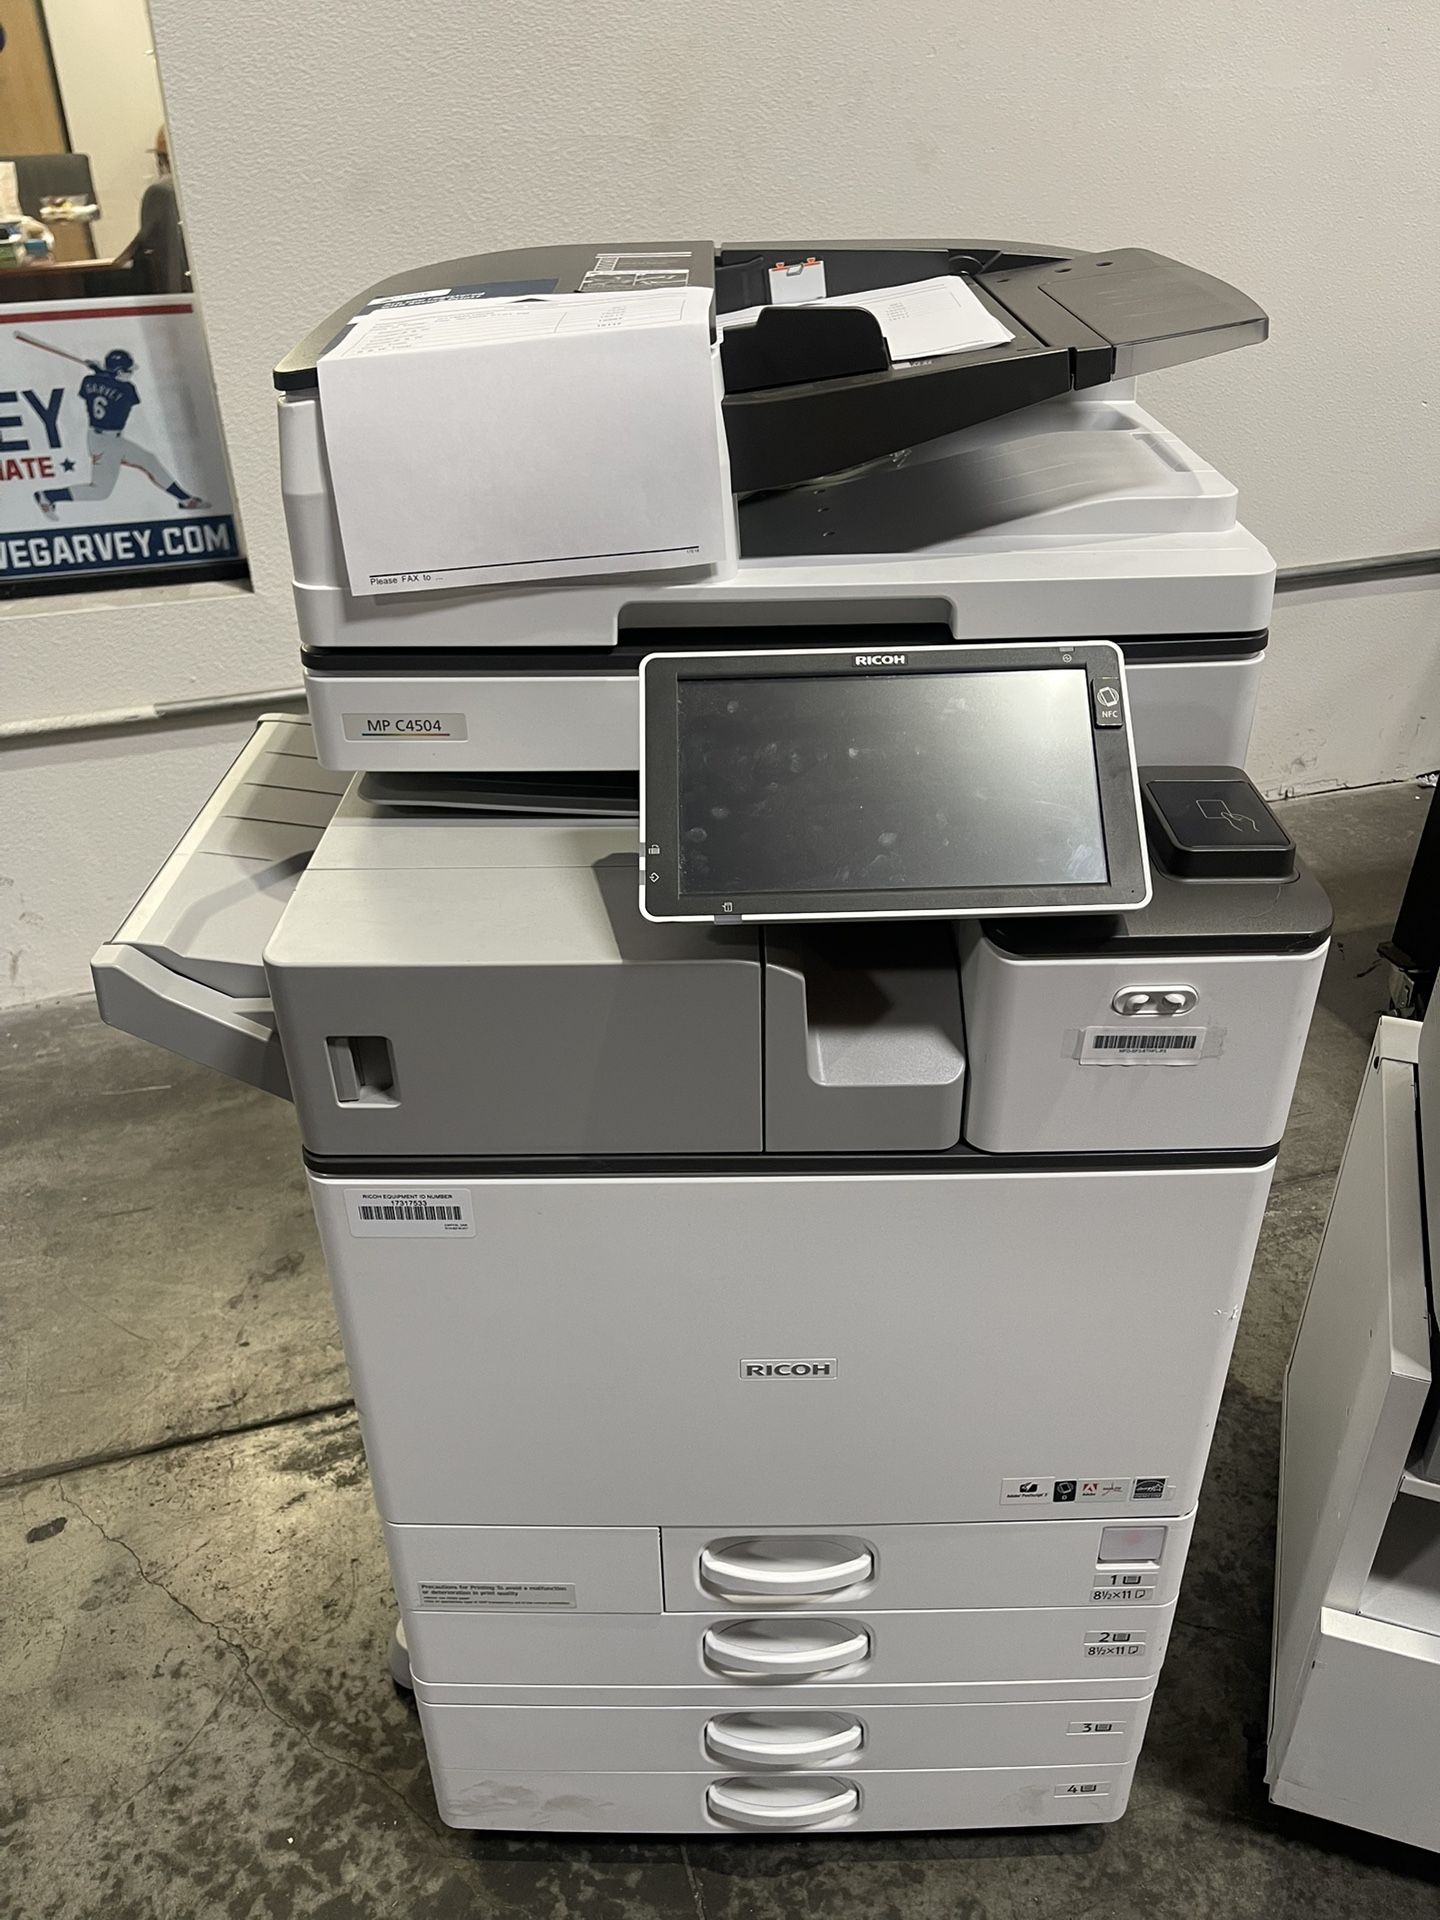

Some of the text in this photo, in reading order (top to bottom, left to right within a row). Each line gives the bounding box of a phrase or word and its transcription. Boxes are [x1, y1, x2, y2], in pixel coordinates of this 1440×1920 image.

[93, 396, 108, 420] 6
[855, 654, 906, 666] RICOH
[1102, 710, 1118, 718] NFC
[367, 720, 442, 731] MP C4504
[746, 1363, 830, 1376] RICOH
[1110, 1575, 1117, 1585] 1
[1099, 1632, 1110, 1642] 2
[1082, 1723, 1092, 1732] 3
[1067, 1785, 1077, 1793] 4
